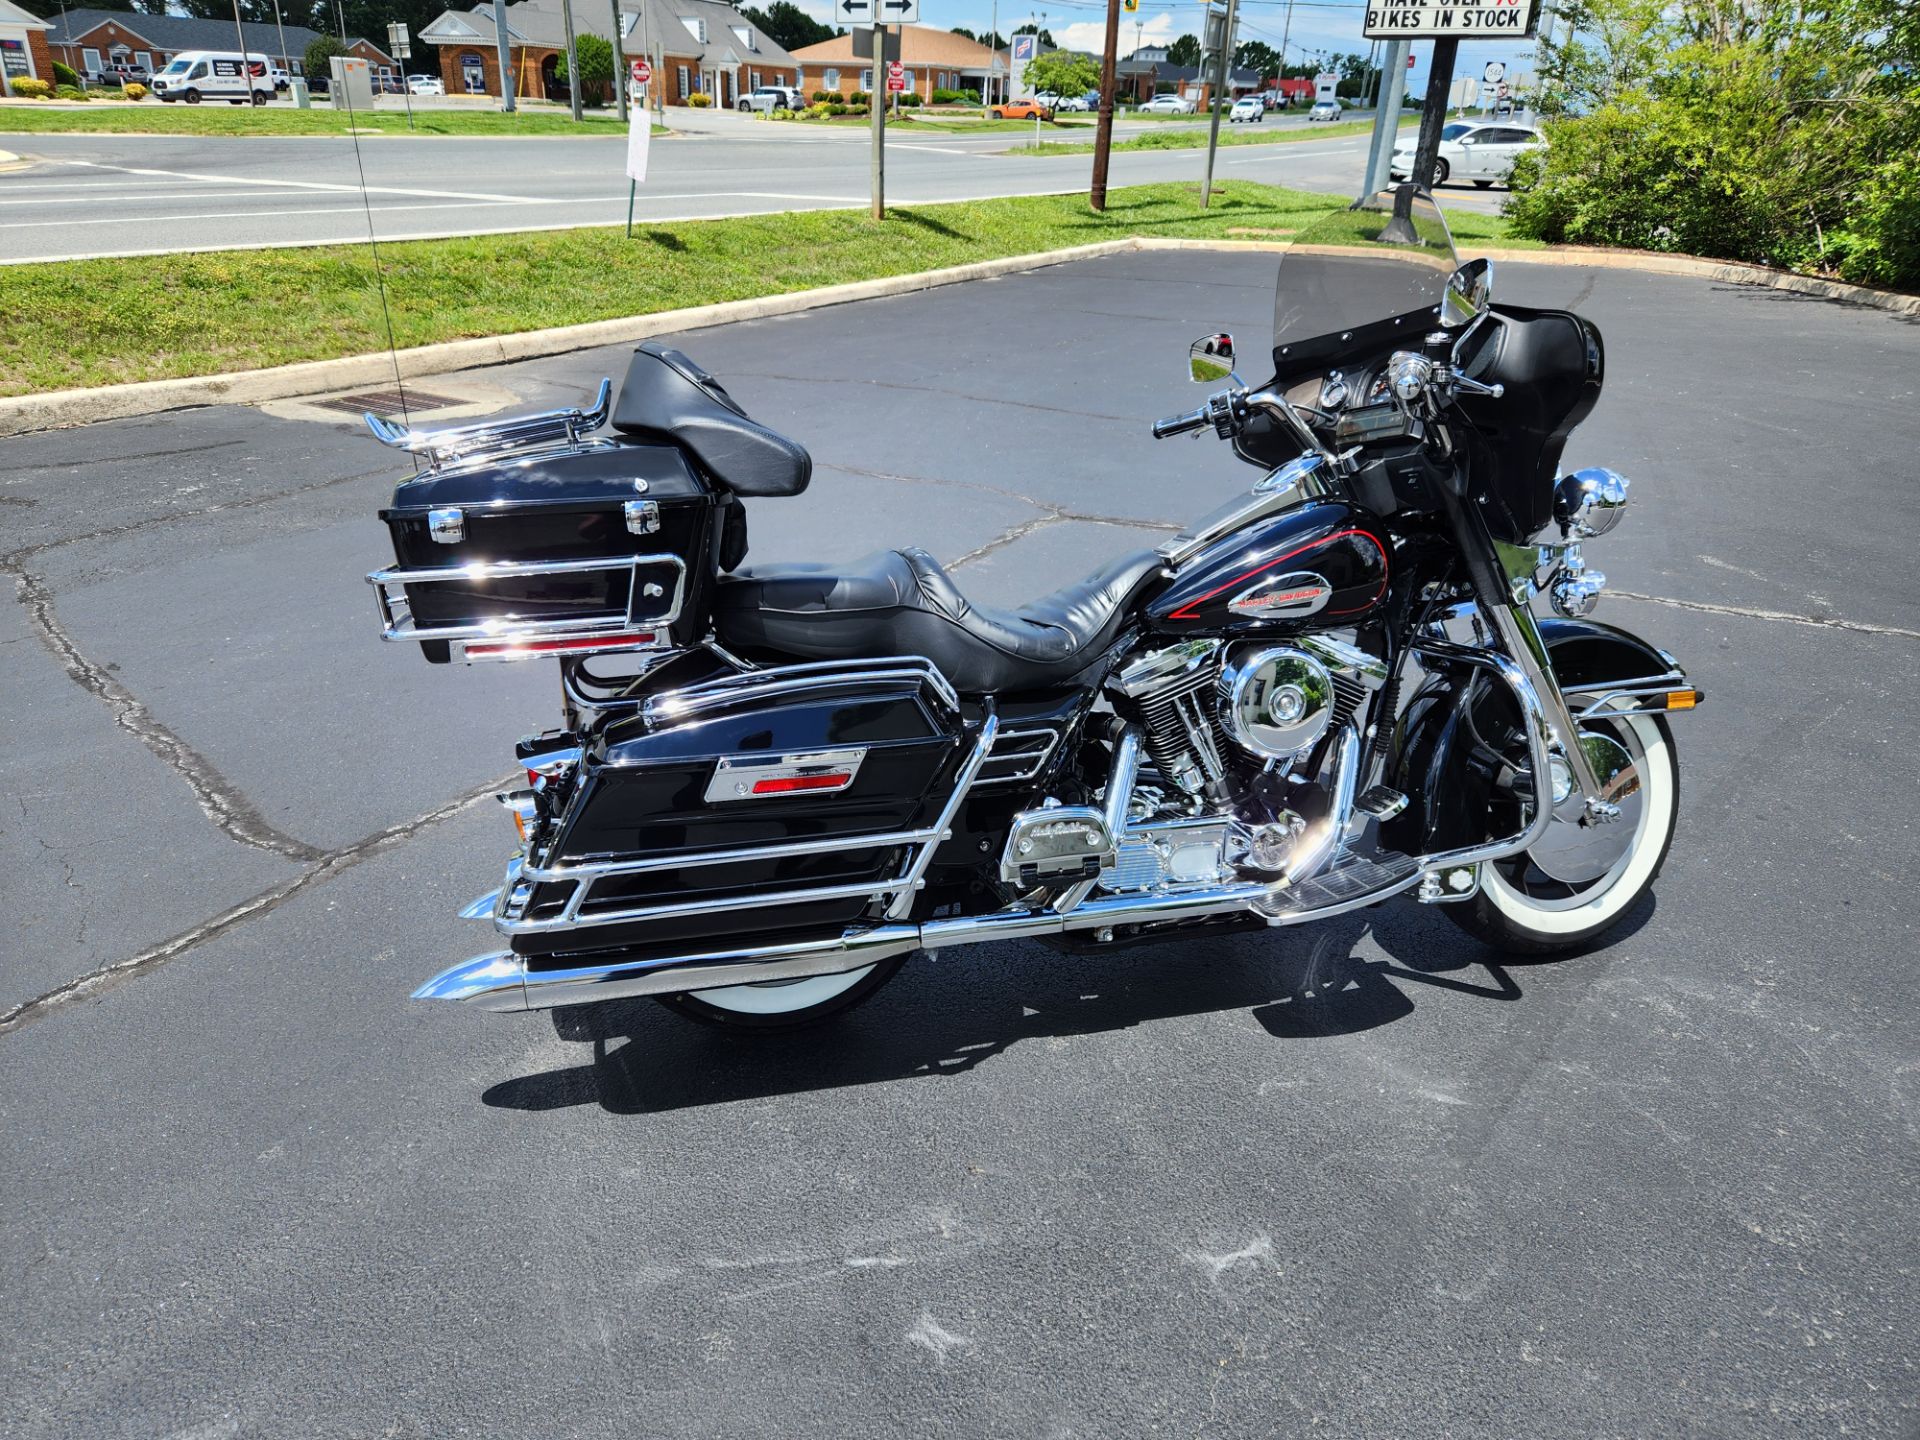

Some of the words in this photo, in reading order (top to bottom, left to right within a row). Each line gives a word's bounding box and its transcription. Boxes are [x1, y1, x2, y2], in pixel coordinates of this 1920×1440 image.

[1367, 10, 1421, 28] BIKES
[1434, 9, 1454, 28] IN
[1462, 9, 1521, 28] STOCK
